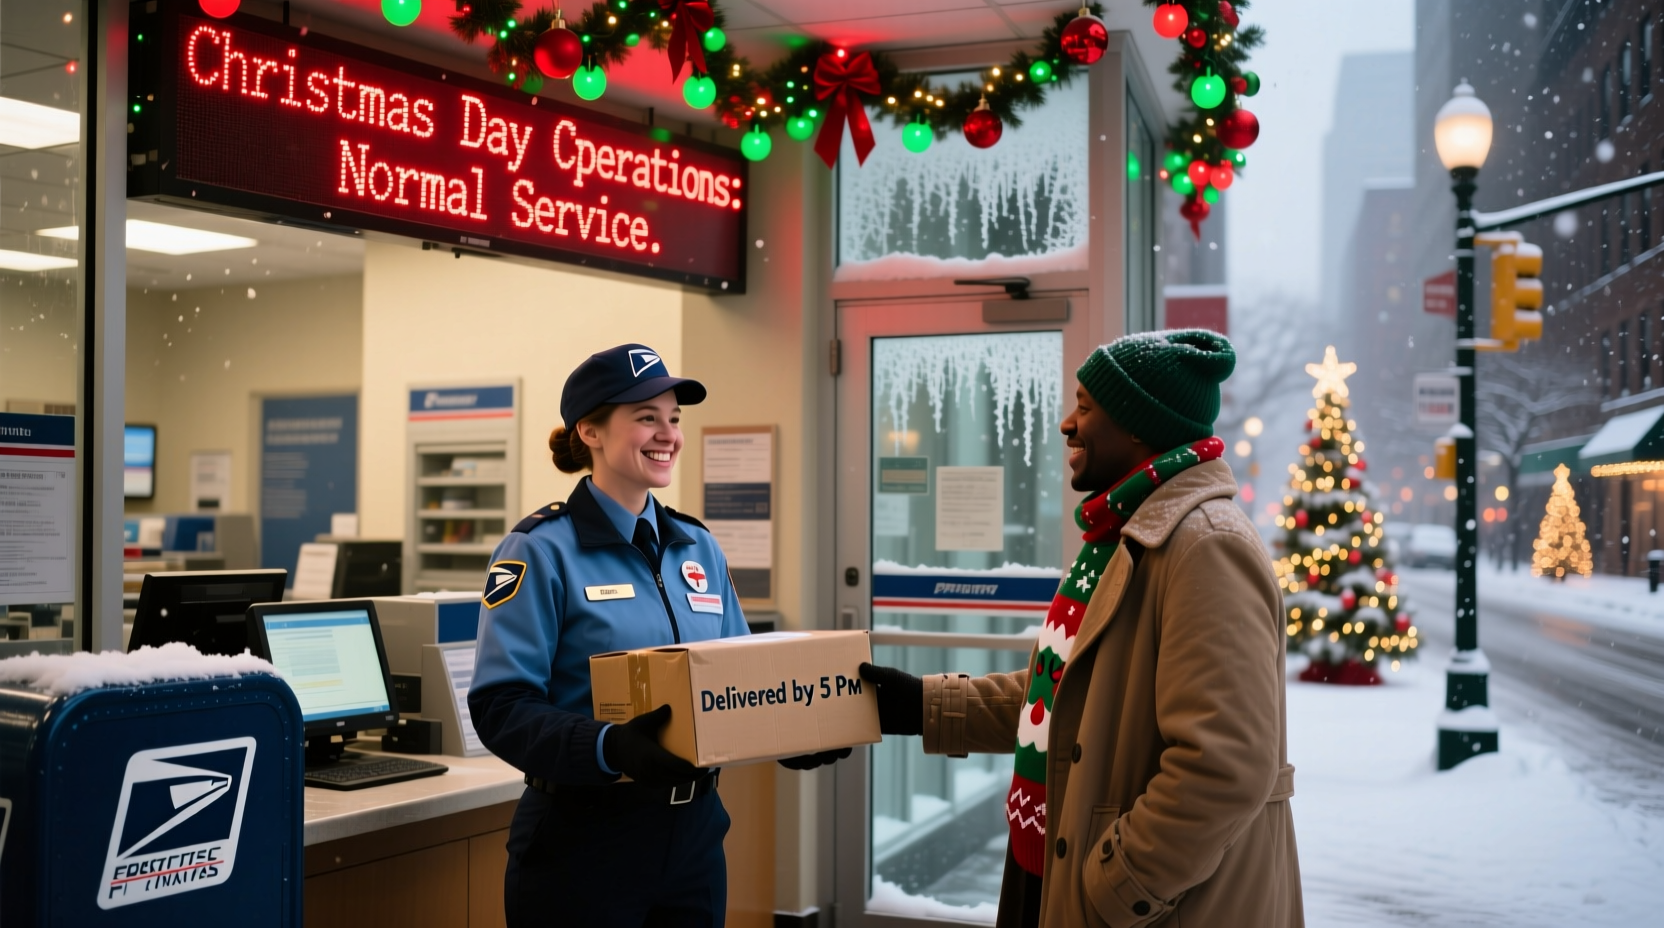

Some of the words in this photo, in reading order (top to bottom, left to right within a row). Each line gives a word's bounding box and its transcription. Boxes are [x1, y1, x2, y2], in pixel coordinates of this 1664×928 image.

[187, 25, 434, 138] Christmas
[460, 94, 533, 172] Day
[553, 119, 741, 210] Cperations:
[338, 140, 487, 220] Normal
[511, 179, 660, 253] Service.
[701, 681, 787, 712] Delivered
[792, 679, 814, 707] by
[820, 676, 831, 699] 5
